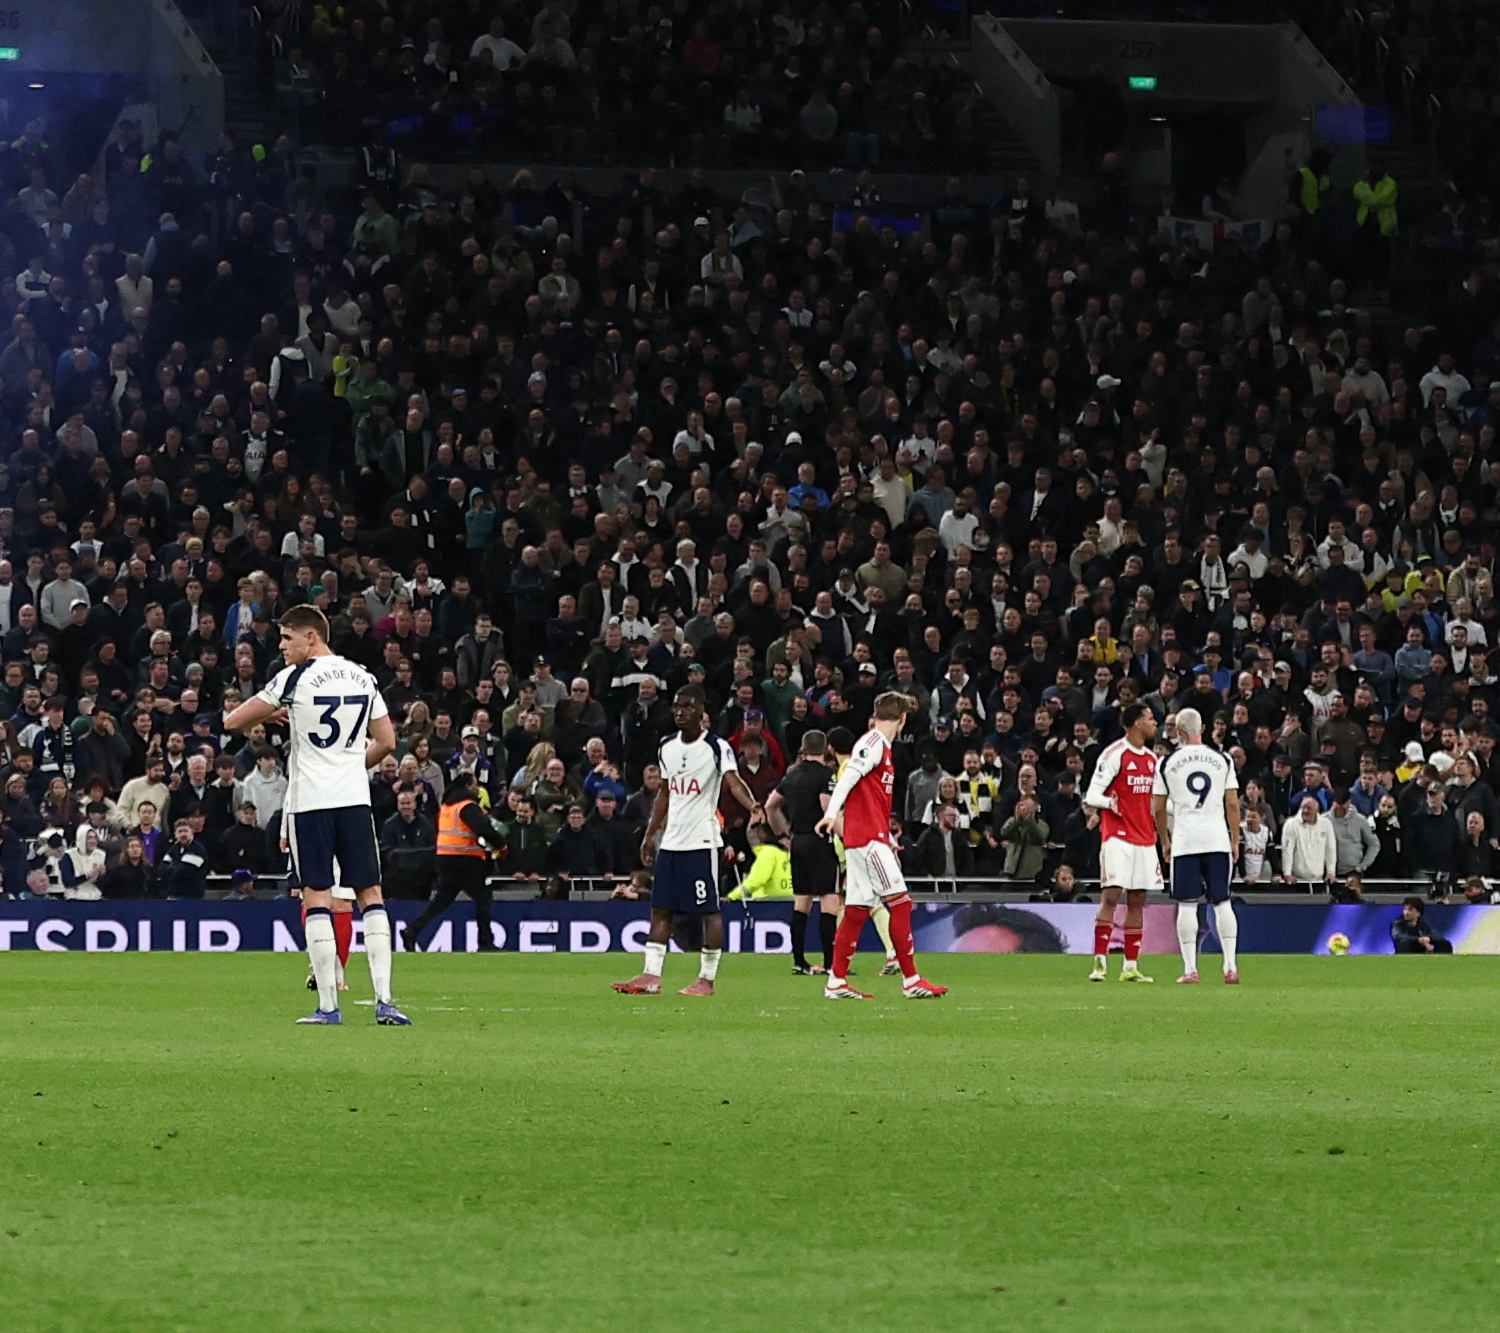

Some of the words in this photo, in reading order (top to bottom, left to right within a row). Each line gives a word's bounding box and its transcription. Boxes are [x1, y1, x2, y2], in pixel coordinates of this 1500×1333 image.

[1119, 40, 1155, 59] 257
[246, 451, 267, 461] AIA
[308, 695, 368, 749] 37
[1171, 755, 1223, 775] RICHARLISON
[668, 778, 702, 796] AIA
[1187, 771, 1212, 810] 9
[694, 879, 707, 899] 8
